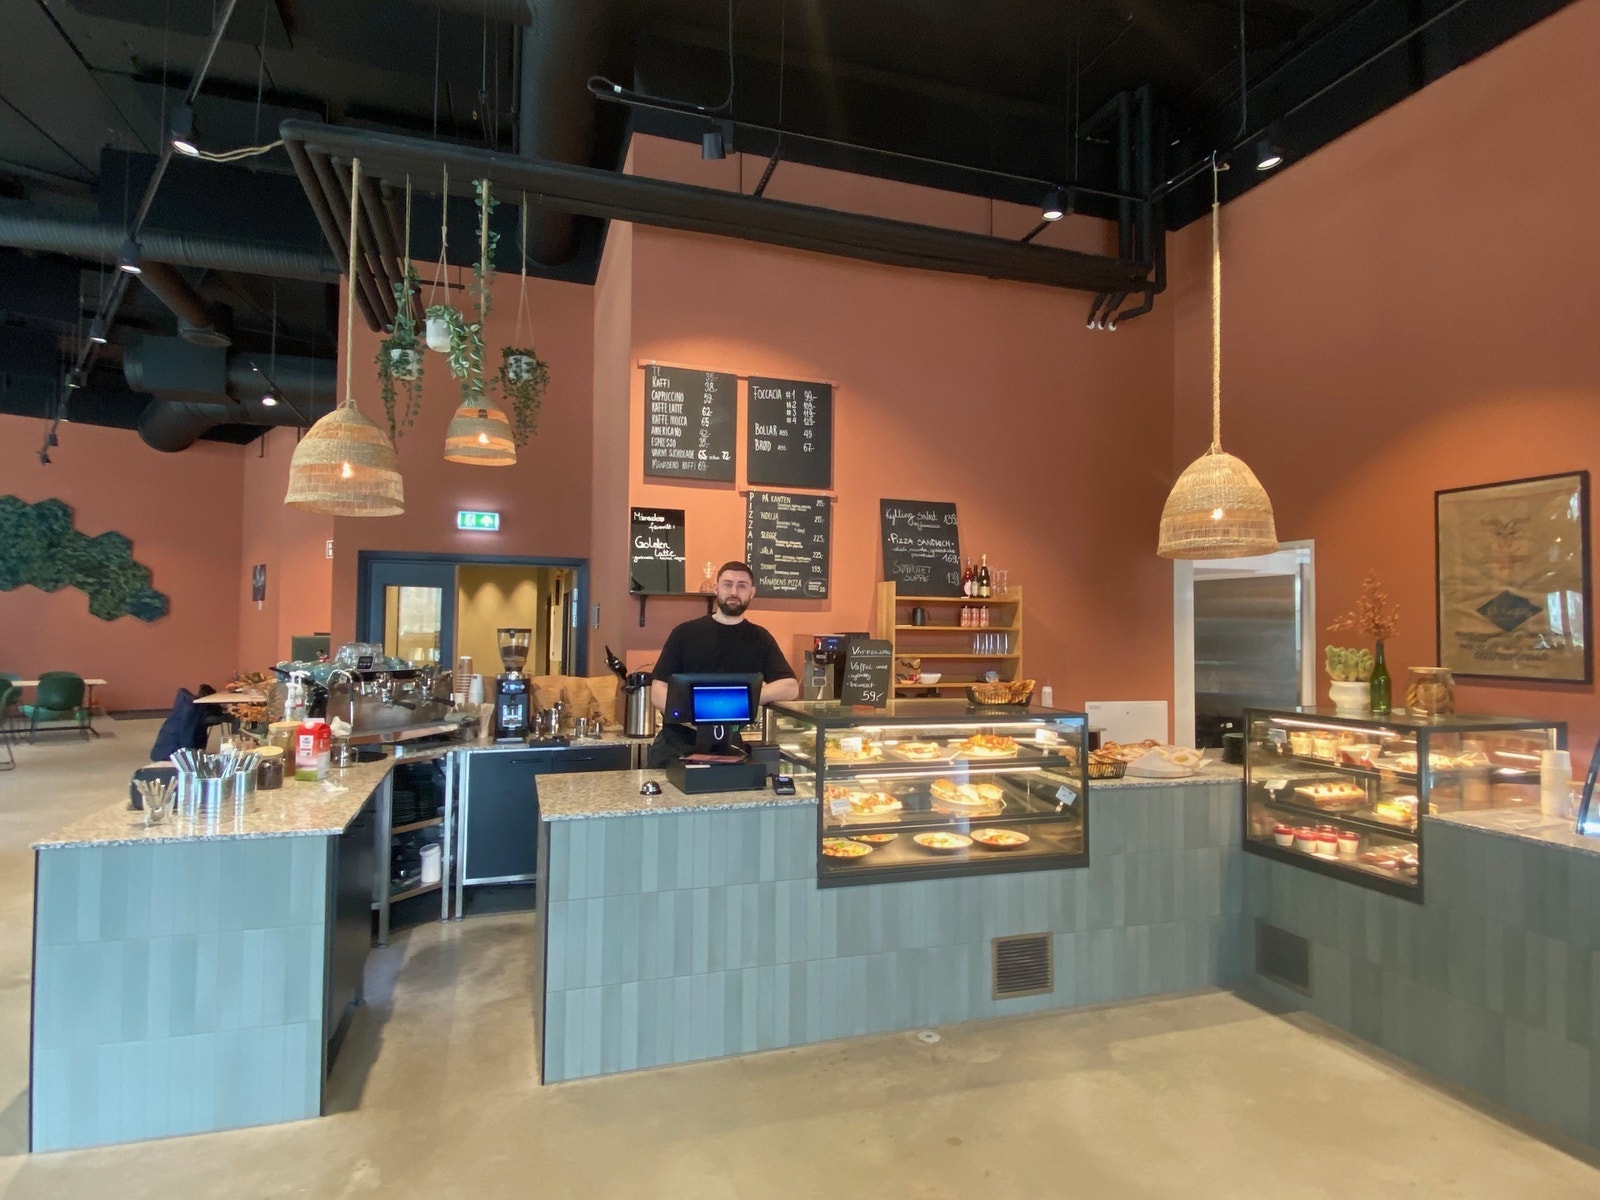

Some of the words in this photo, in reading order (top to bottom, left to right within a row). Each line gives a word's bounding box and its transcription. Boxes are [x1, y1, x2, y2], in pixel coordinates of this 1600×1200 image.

[651, 389, 685, 403] CAPPUCCINO
[668, 402, 683, 414] LATTE
[651, 426, 682, 437] AMERICANO
[771, 496, 791, 504] KANTEN
[635, 535, 671, 549] Golden
